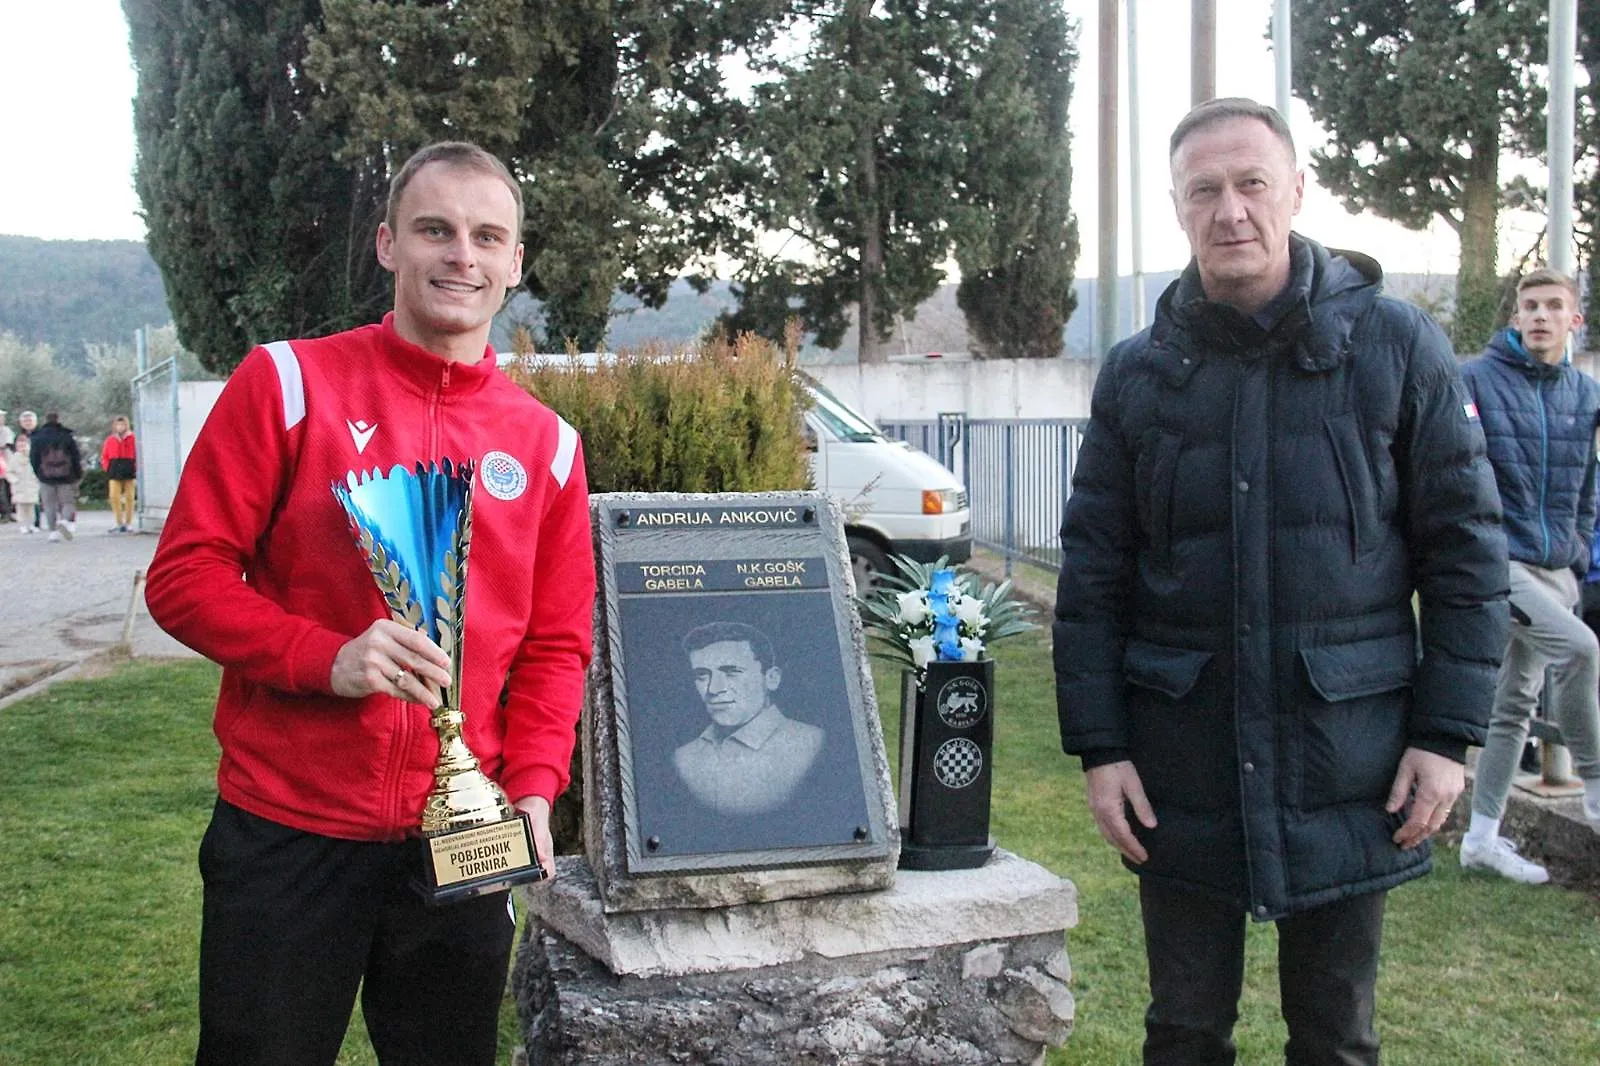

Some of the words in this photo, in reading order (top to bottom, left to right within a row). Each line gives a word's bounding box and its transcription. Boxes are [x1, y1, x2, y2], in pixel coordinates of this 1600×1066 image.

[636, 512, 713, 526] ANDRIJA
[719, 508, 798, 524] ANKOVIĆ
[640, 565, 706, 577] TORCIDA
[645, 578, 704, 591] GABELA
[744, 575, 802, 588] GABELA
[450, 841, 512, 865] POBJEDNIK
[458, 856, 509, 877] TURNIRA
